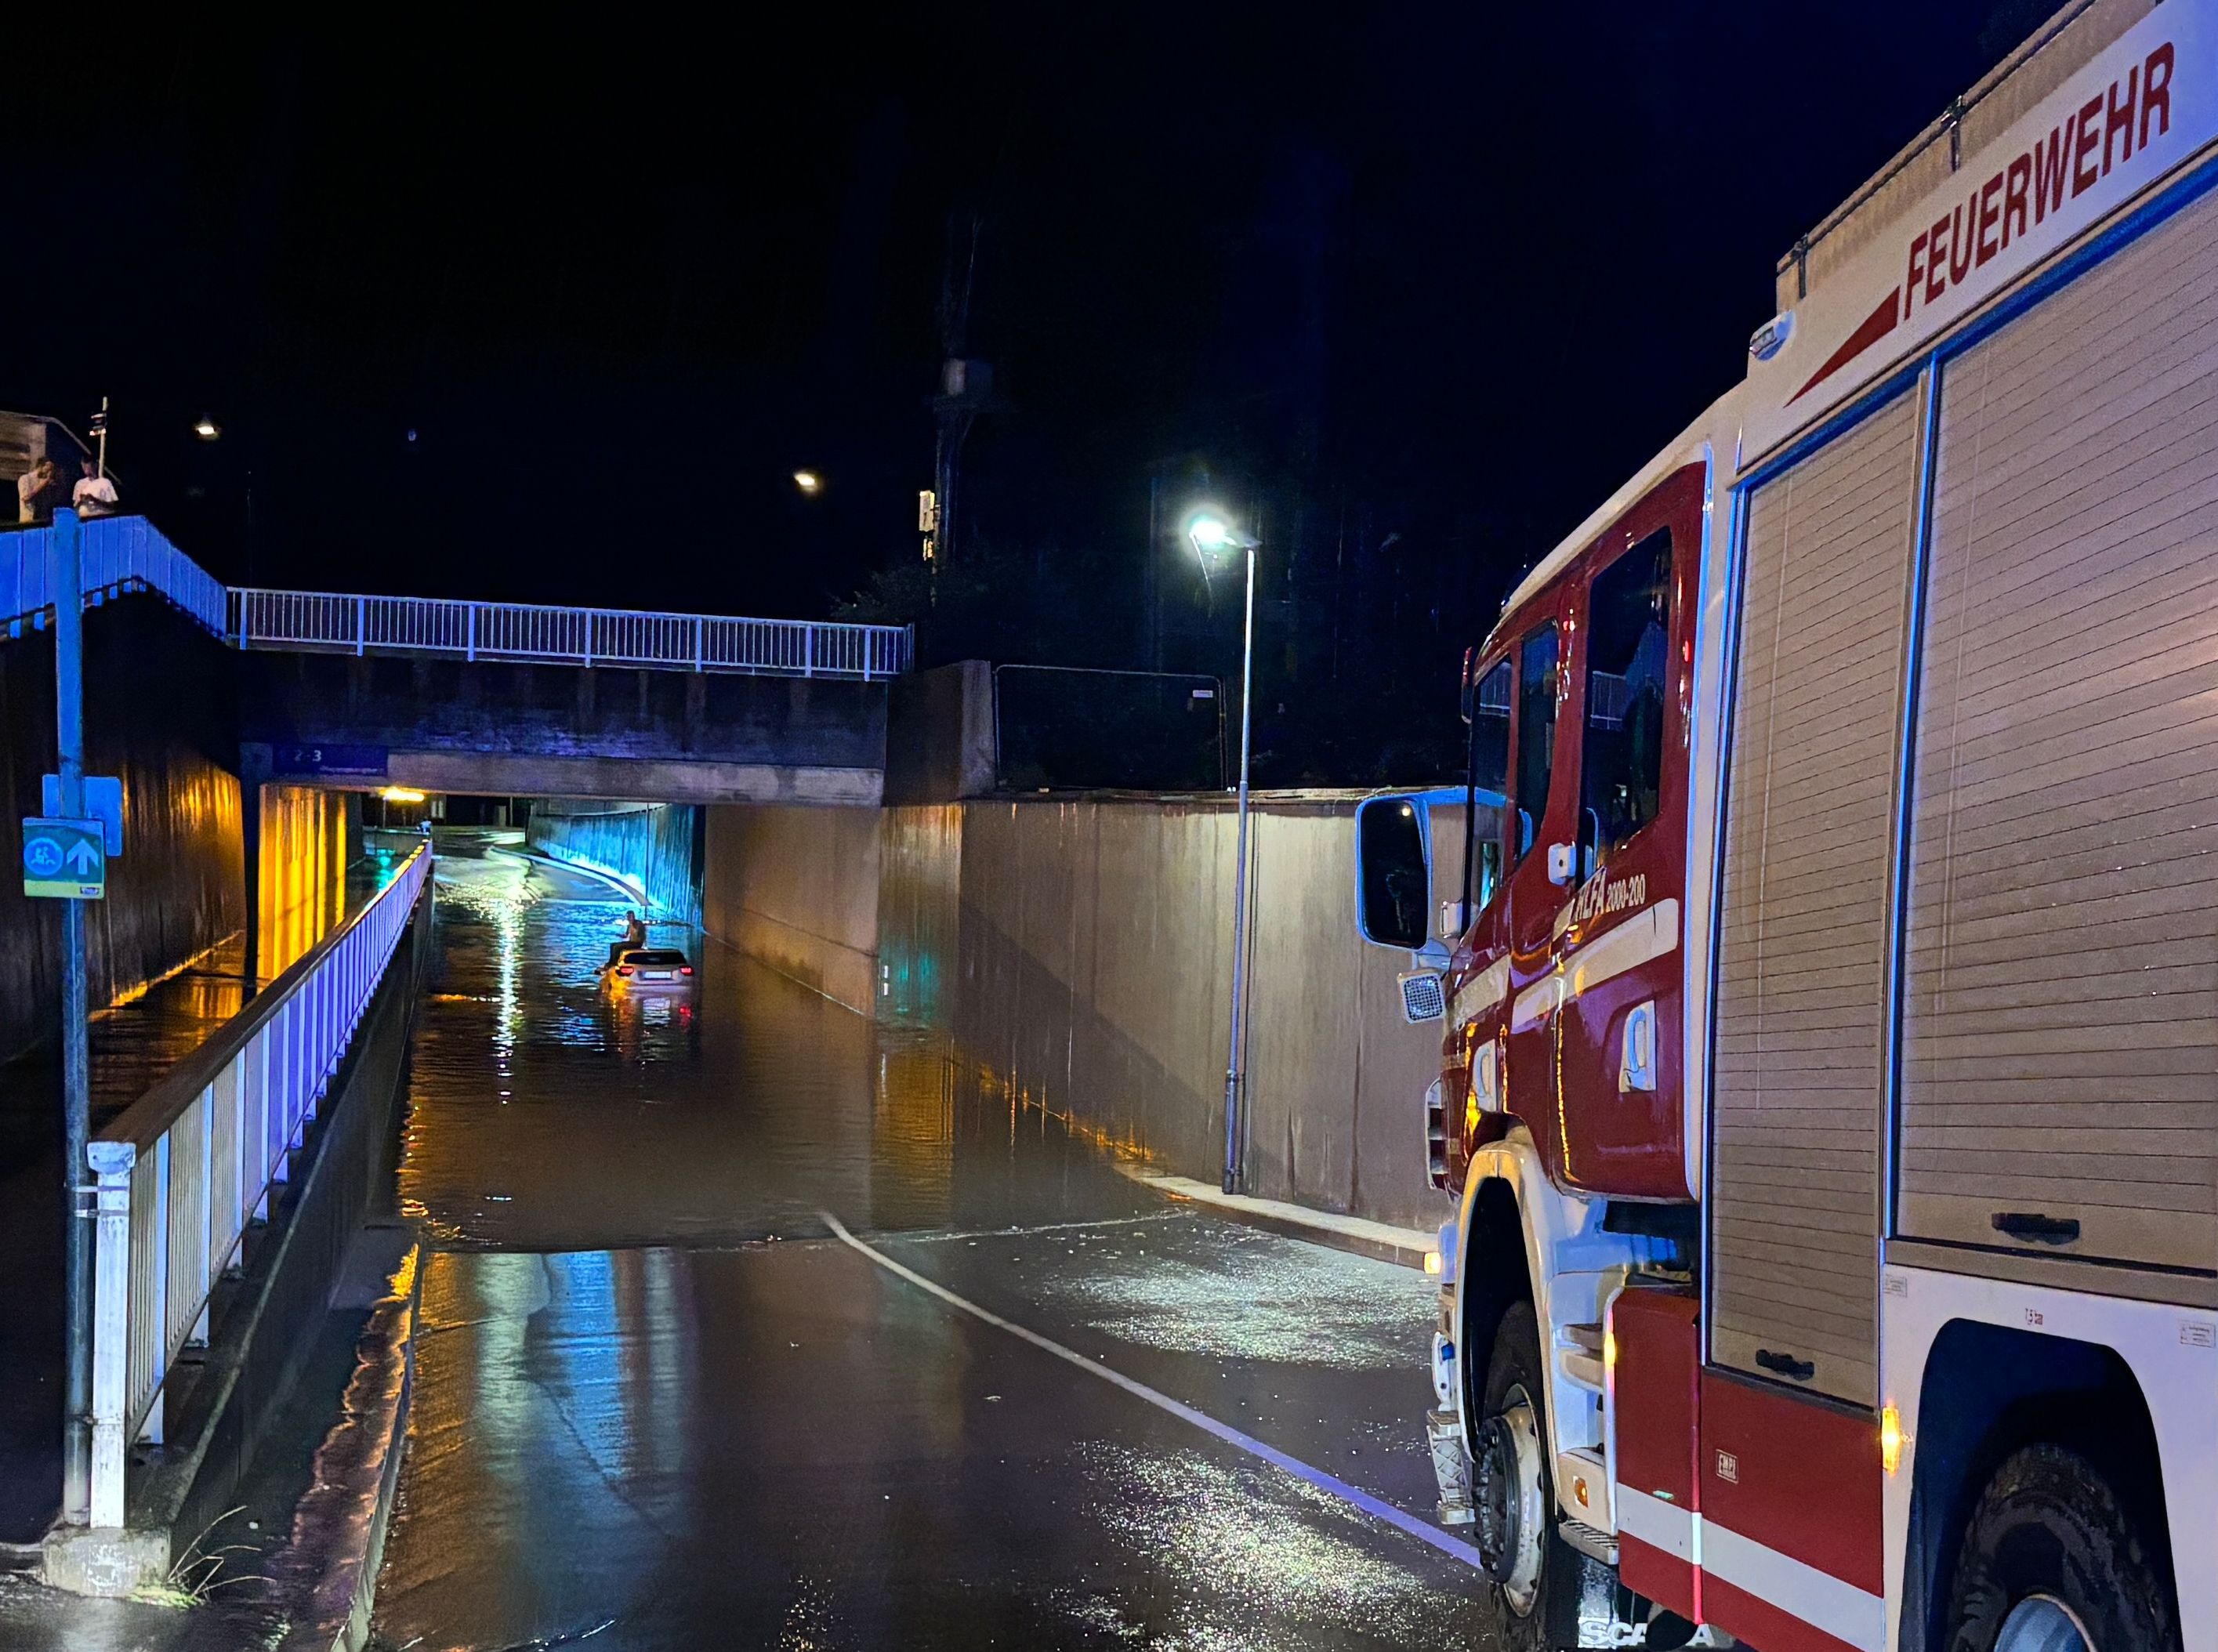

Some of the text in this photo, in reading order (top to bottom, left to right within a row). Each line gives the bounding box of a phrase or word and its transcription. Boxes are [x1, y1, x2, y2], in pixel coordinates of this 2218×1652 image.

[1904, 42, 2175, 321] FEUERWEHR
[1606, 873, 1646, 913] 2000-200
[1580, 1621, 1716, 1647] SCAA
